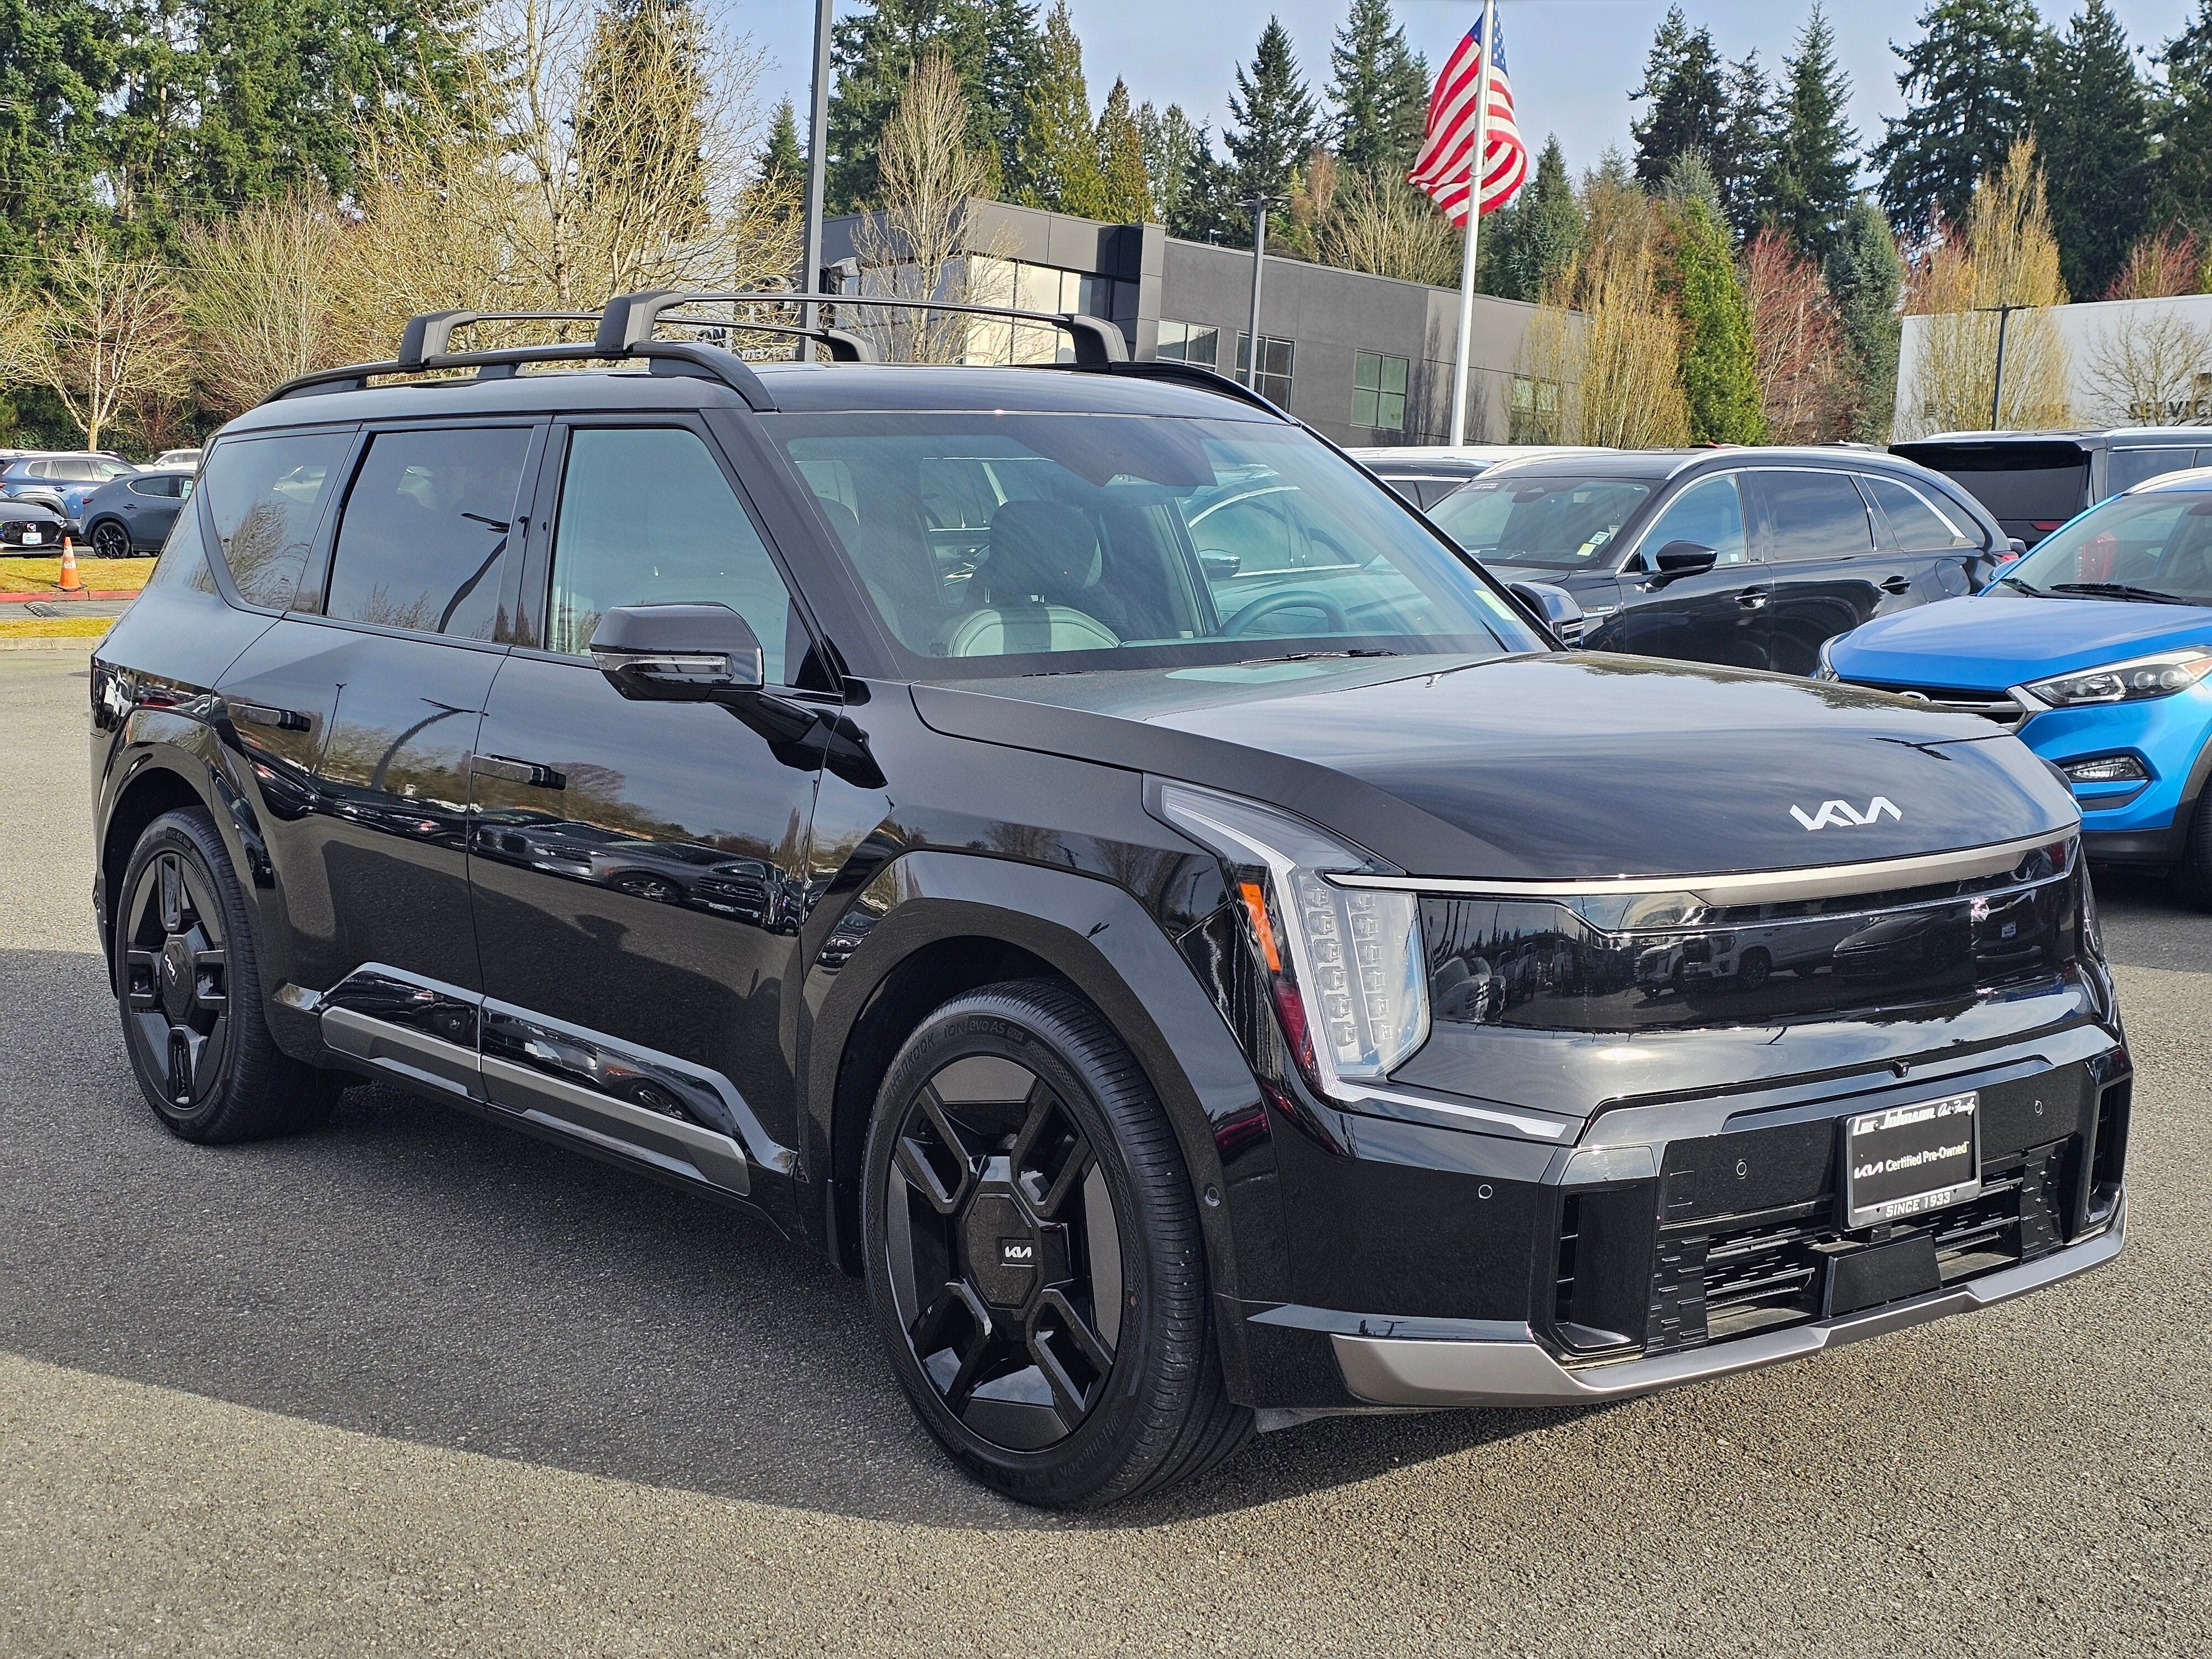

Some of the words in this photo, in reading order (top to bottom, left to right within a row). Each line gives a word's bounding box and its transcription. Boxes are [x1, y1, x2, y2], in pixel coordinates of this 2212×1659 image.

[1789, 796, 1902, 831] KIA
[990, 1021, 1006, 1034] AS
[1880, 1108, 1936, 1130] Johnson
[1854, 1161, 1884, 1179] KIA
[1886, 1152, 1922, 1172] Certified
[1923, 1142, 1969, 1163] Pre-Owned
[1886, 1199, 1919, 1218] SINCE
[1924, 1192, 1951, 1209] 1933
[1005, 1246, 1032, 1258] KIA
